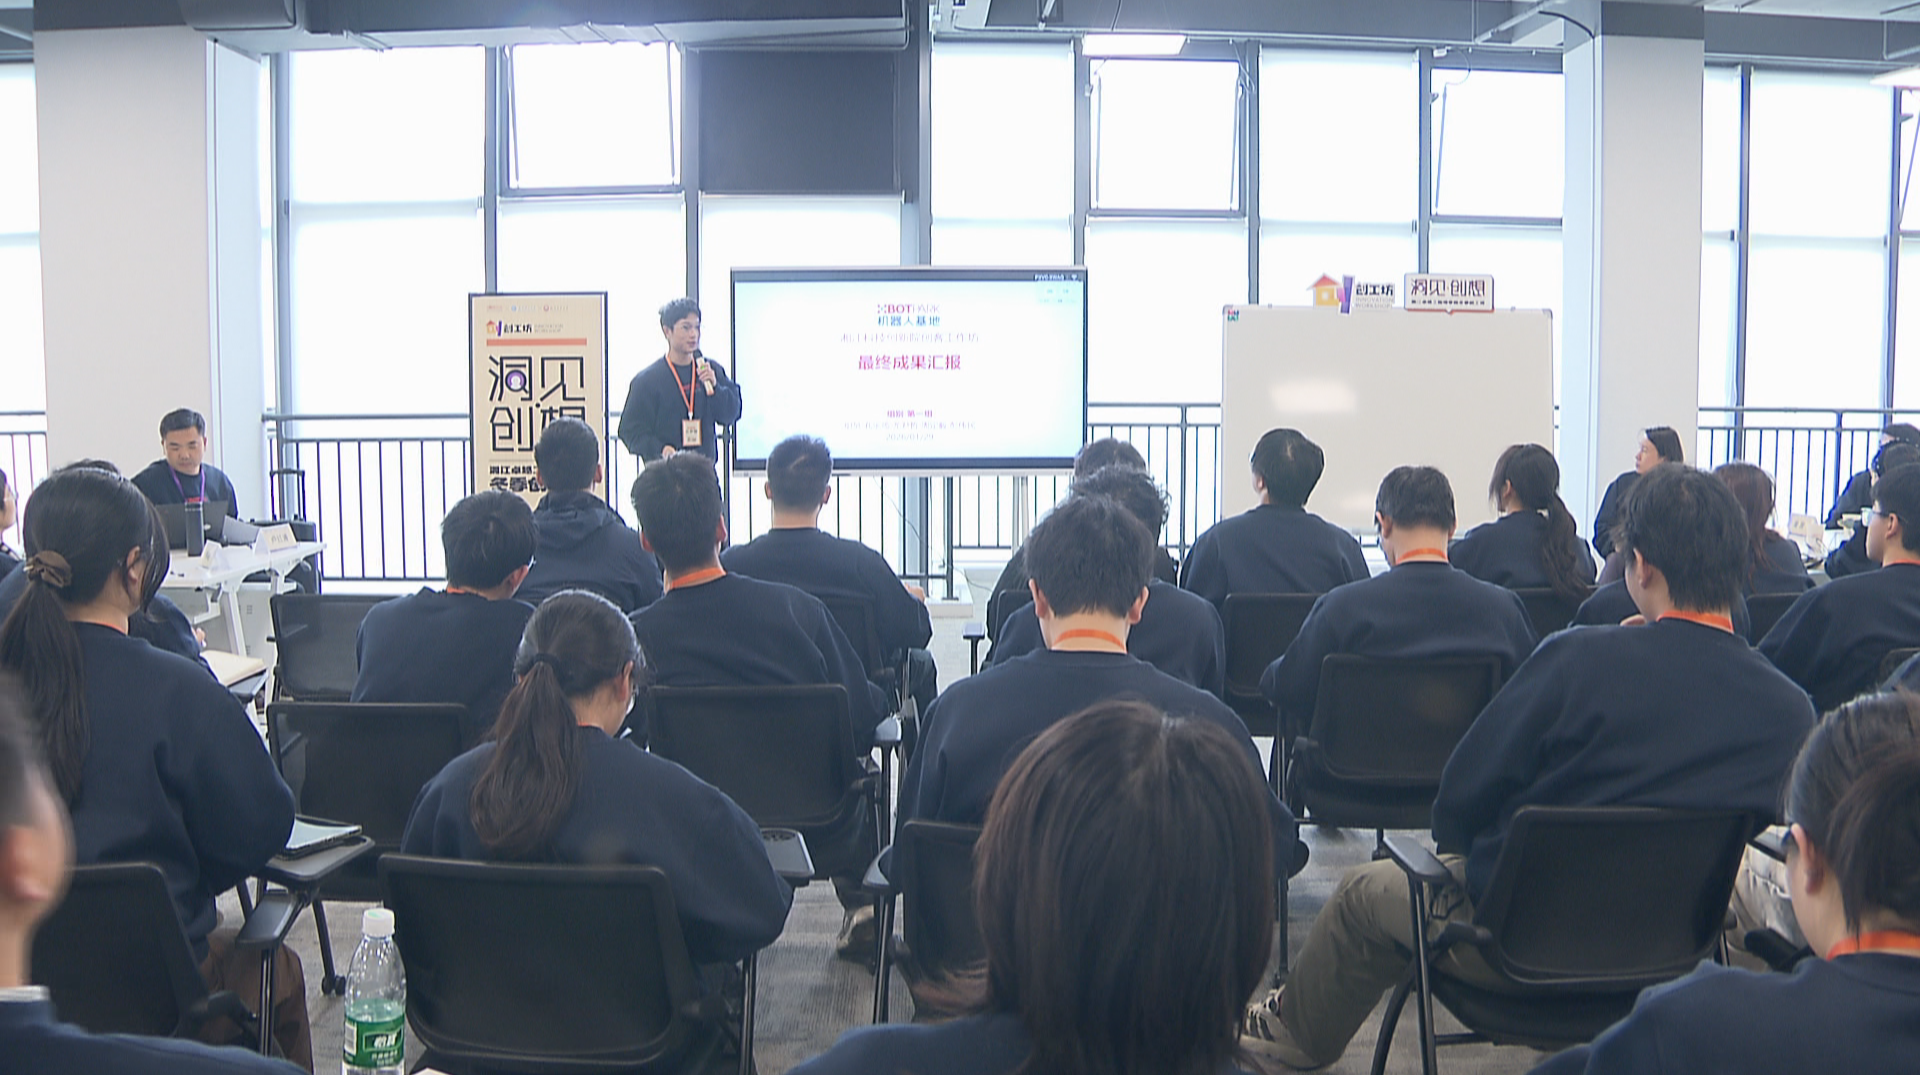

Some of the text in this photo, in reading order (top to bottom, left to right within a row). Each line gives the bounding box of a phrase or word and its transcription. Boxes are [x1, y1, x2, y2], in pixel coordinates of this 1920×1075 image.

[1356, 282, 1393, 296] 创工坊
[877, 315, 941, 327] 机器人基地
[503, 323, 532, 334] 创工坊
[858, 354, 961, 371] 最终成果汇报
[489, 355, 586, 402] 洞见
